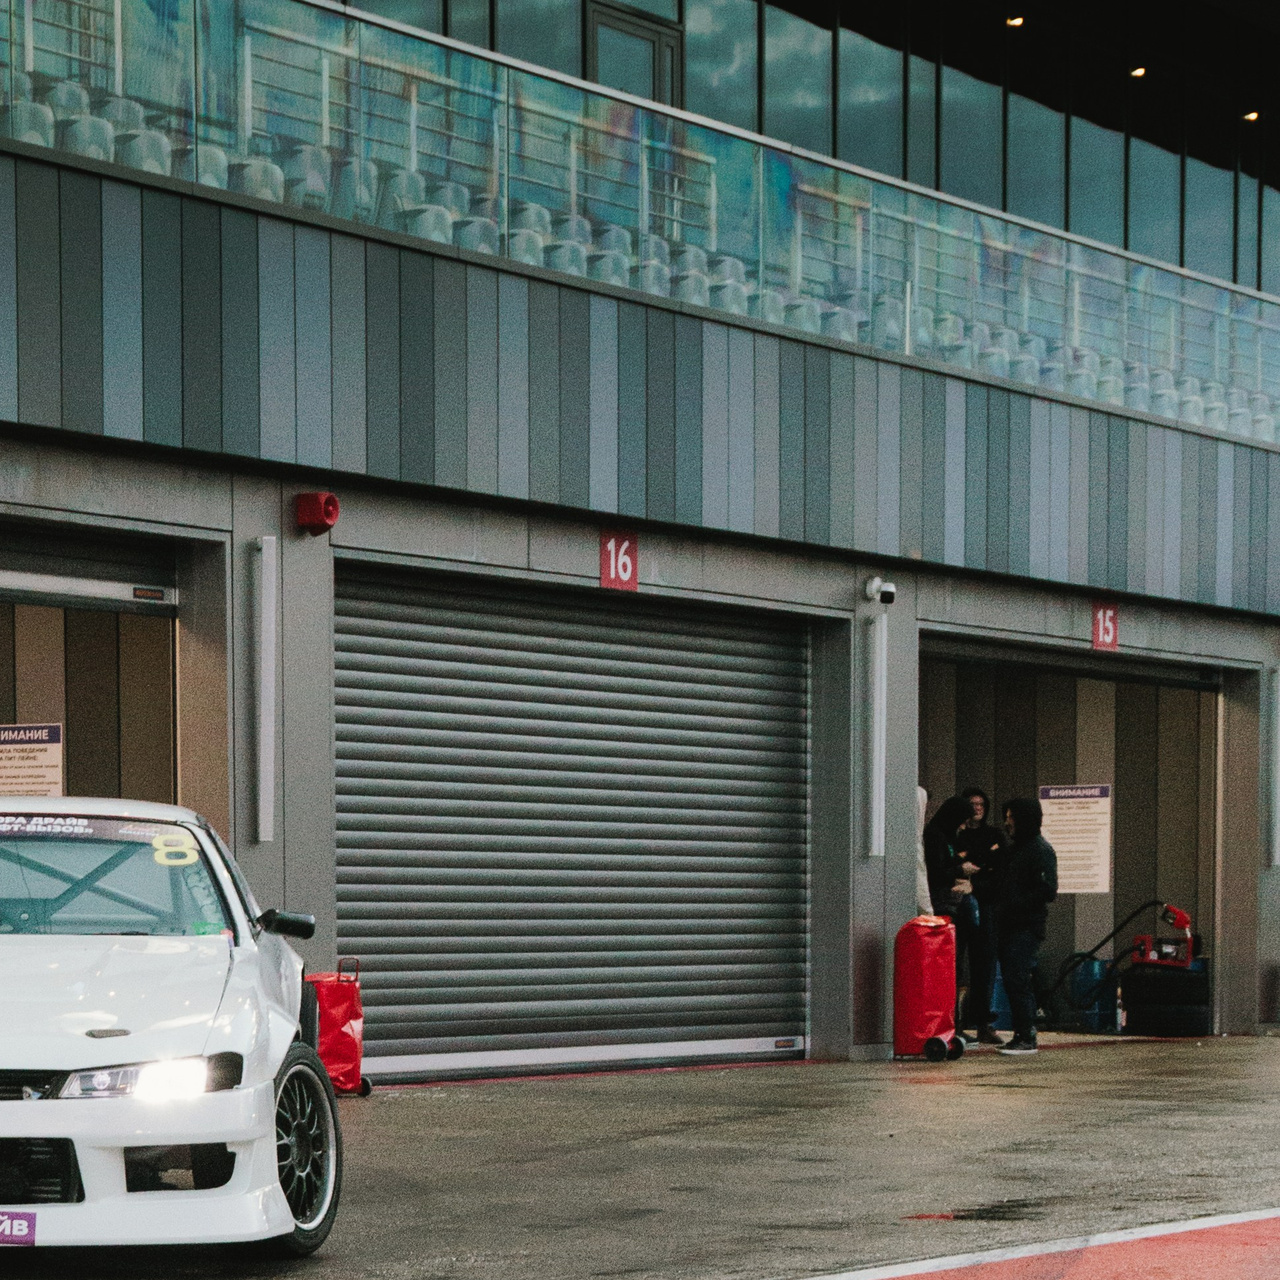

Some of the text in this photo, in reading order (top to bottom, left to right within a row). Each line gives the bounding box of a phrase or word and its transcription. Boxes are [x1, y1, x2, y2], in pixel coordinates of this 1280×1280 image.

[606, 537, 633, 582] 16
[1097, 608, 1114, 644] 15
[1049, 787, 1101, 797] ВНИМАНИЕ
[30, 816, 89, 826] ДРАЙВ
[151, 834, 199, 866] 8
